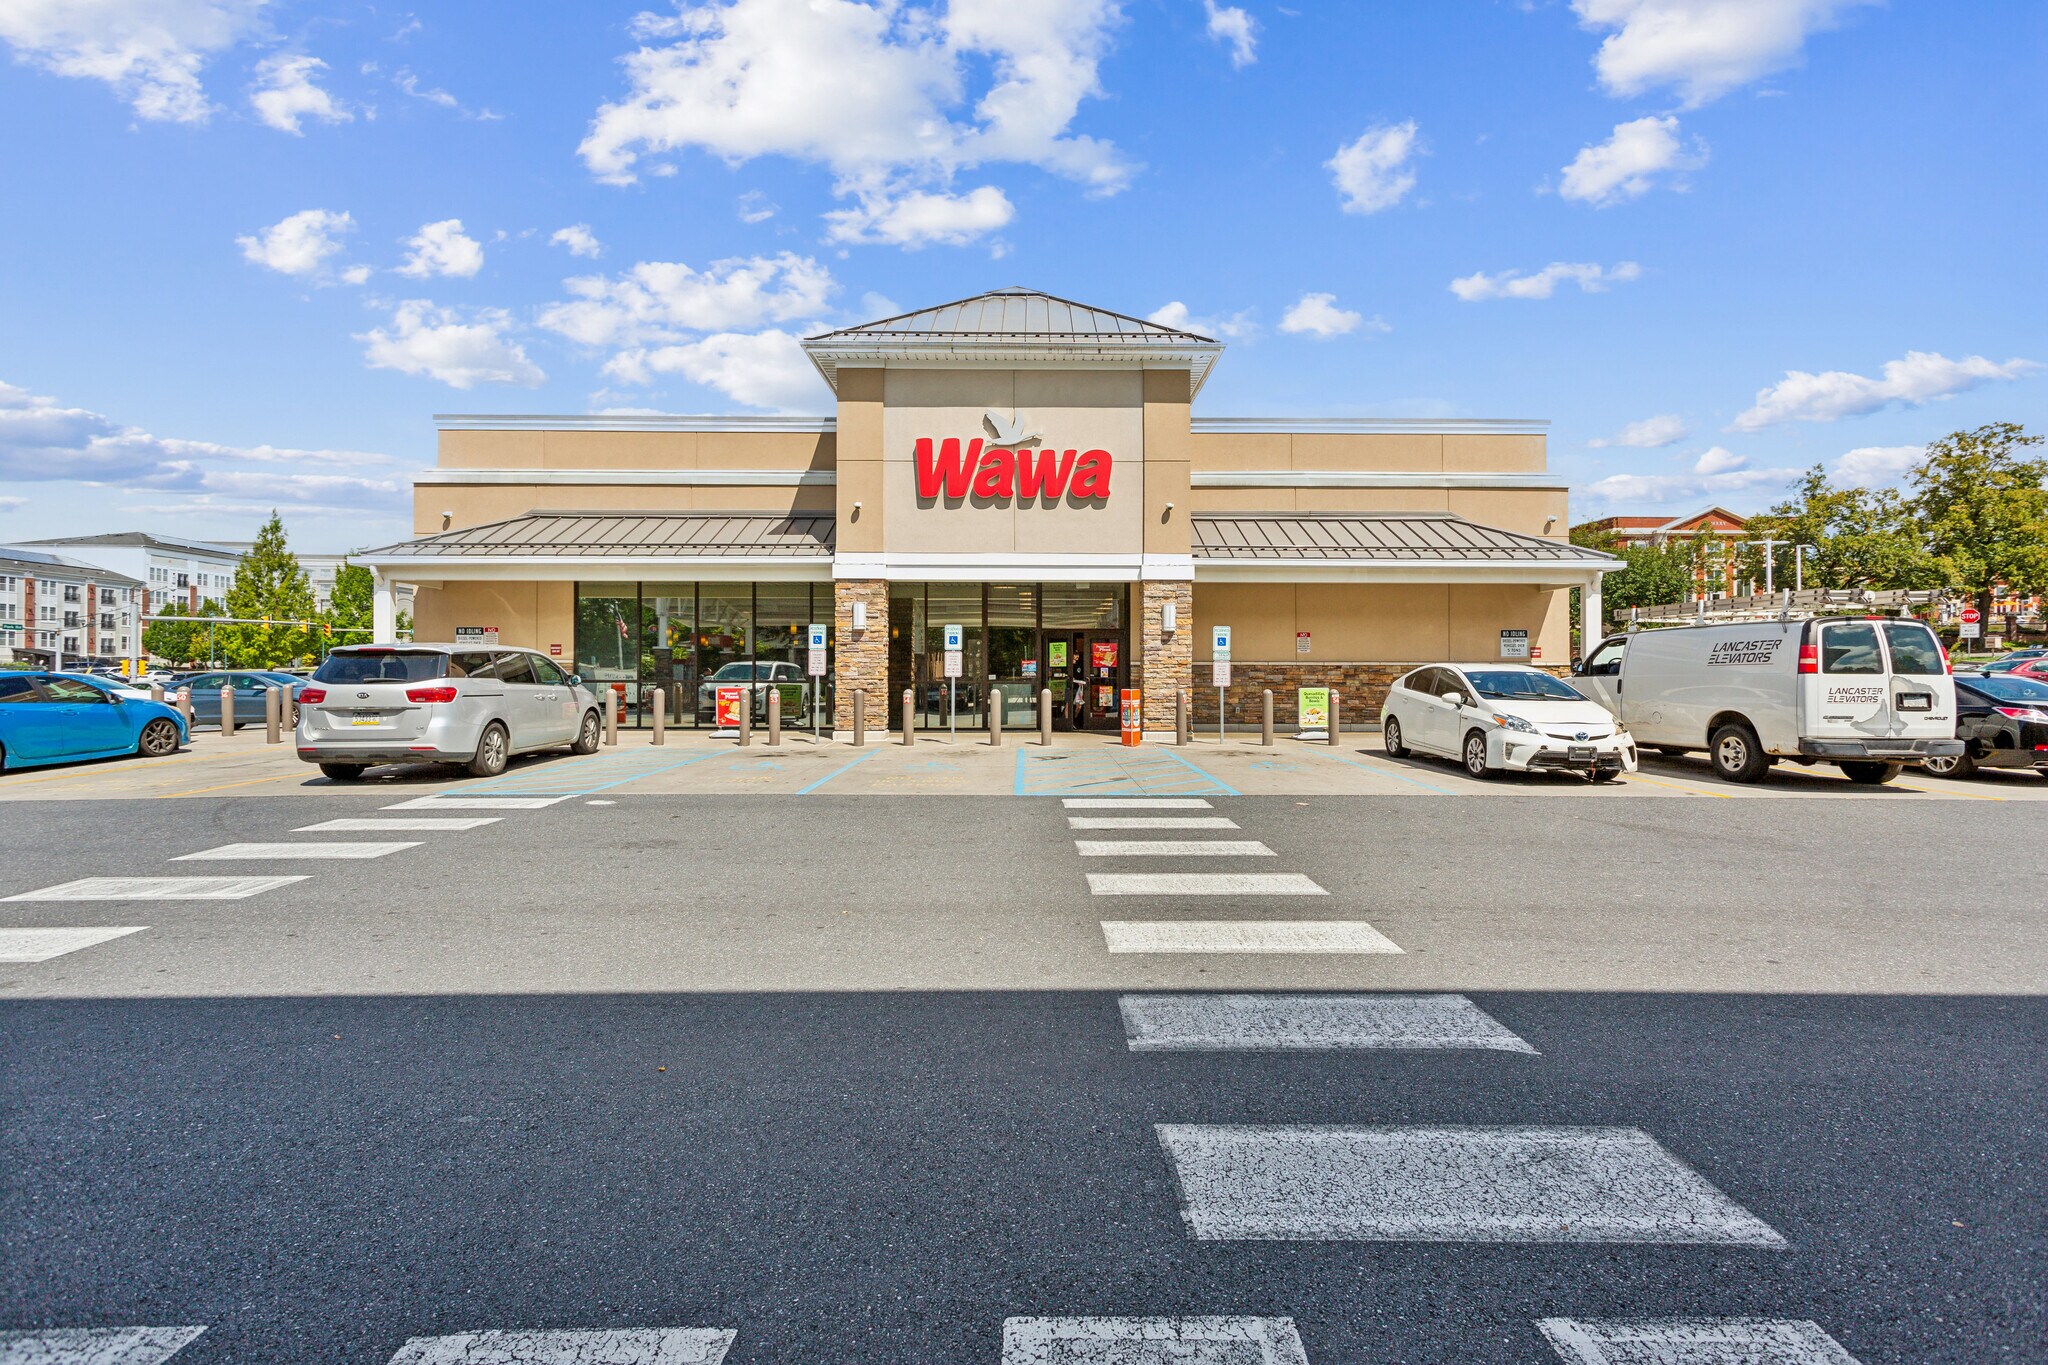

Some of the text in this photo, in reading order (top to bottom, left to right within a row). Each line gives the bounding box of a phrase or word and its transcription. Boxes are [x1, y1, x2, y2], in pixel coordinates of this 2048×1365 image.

[915, 437, 1113, 499] Wawa
[1712, 639, 1782, 652] LANCASTER
[1708, 652, 1772, 664] ELEVATORS
[1829, 687, 1884, 695] LANCASTER
[1827, 695, 1879, 703] ELEVATORS
